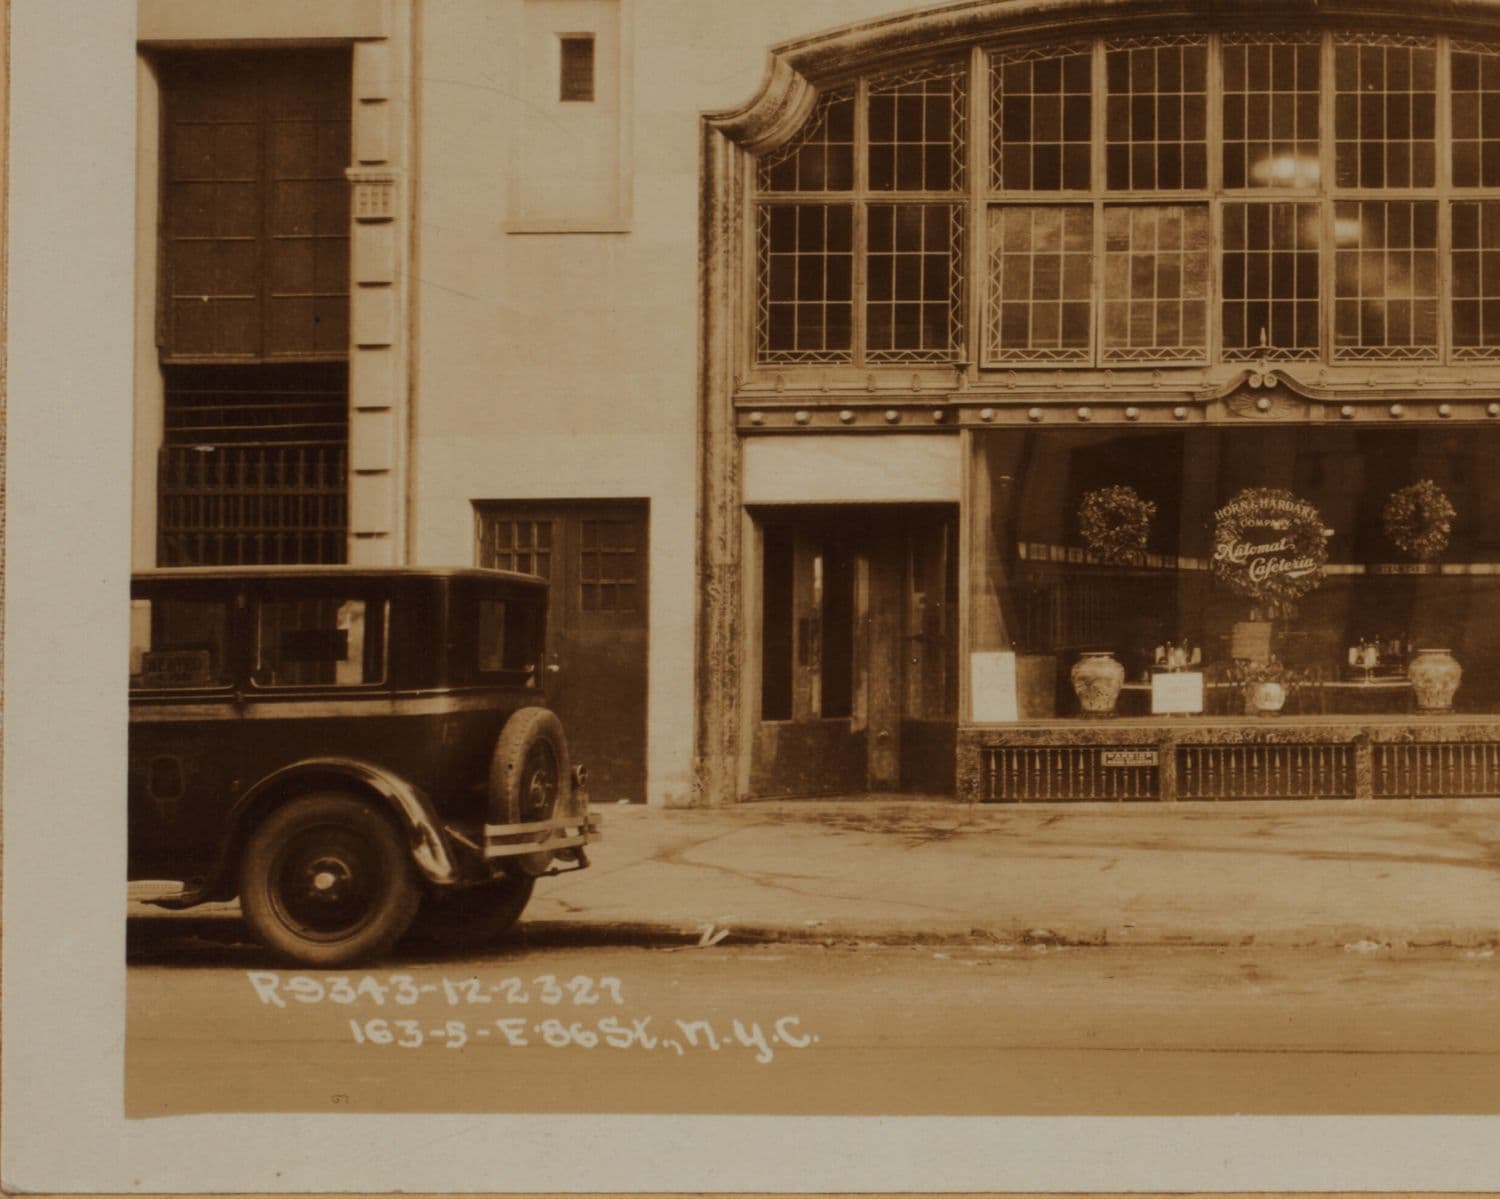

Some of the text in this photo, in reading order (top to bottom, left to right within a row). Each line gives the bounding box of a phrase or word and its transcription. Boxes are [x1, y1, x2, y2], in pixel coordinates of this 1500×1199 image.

[1214, 502, 1248, 521] HORN
[1259, 497, 1319, 520] HARDART
[1213, 538, 1296, 563] Automat
[1249, 557, 1318, 581] Cafeteria
